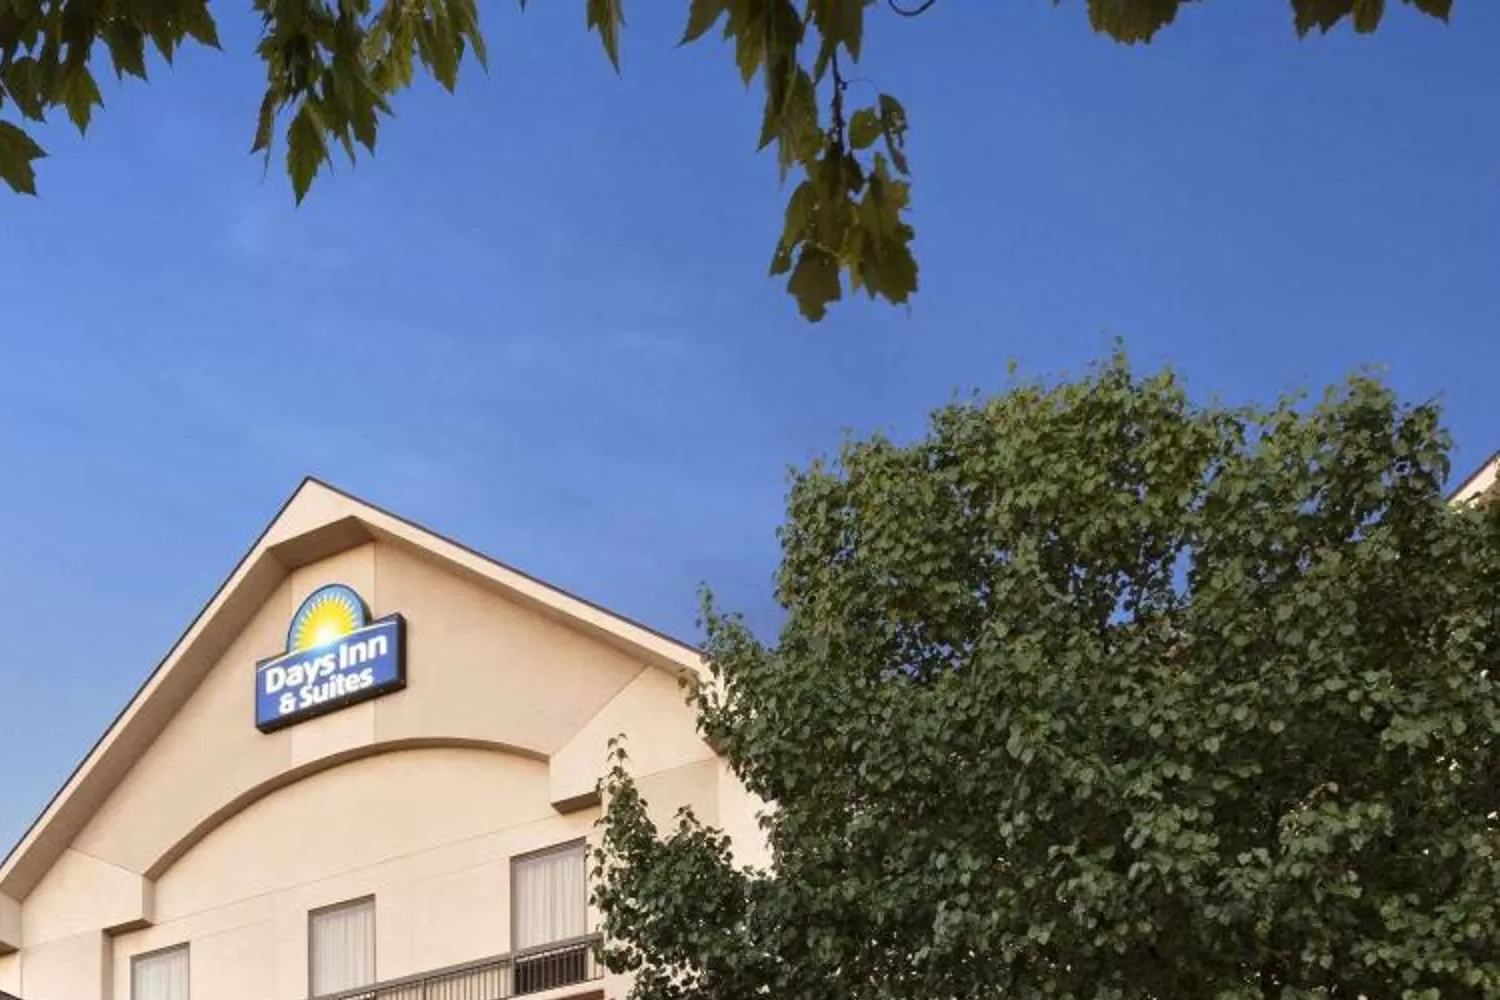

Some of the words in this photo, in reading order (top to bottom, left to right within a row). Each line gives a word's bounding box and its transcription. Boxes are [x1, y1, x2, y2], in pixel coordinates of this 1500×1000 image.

[265, 652, 336, 694] Days
[339, 634, 387, 669] Inn
[279, 692, 296, 714] &
[299, 667, 373, 707] Suites
